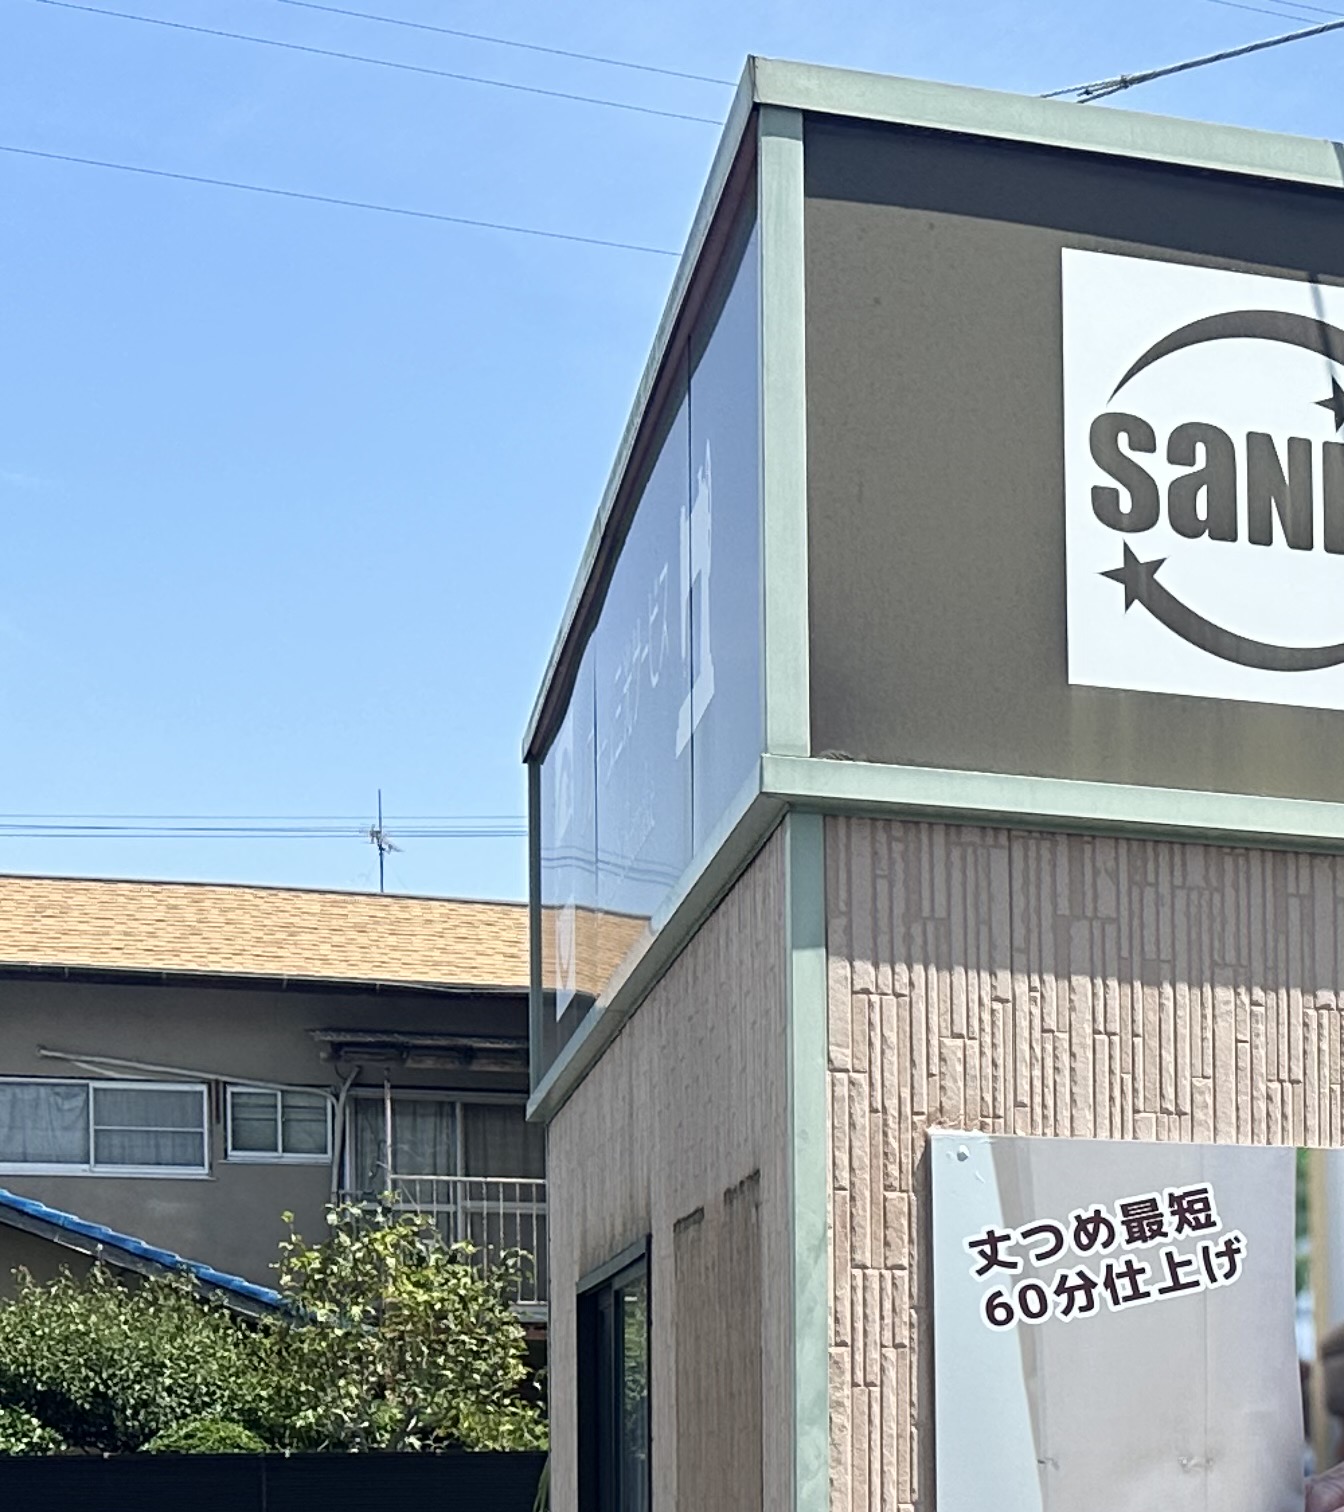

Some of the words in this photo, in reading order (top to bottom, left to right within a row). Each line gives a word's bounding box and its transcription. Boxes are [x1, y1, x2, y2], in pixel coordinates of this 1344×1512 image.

[969, 1187, 1217, 1277] 丈つめ最短
[985, 1235, 1242, 1327] 60分仕上げ
